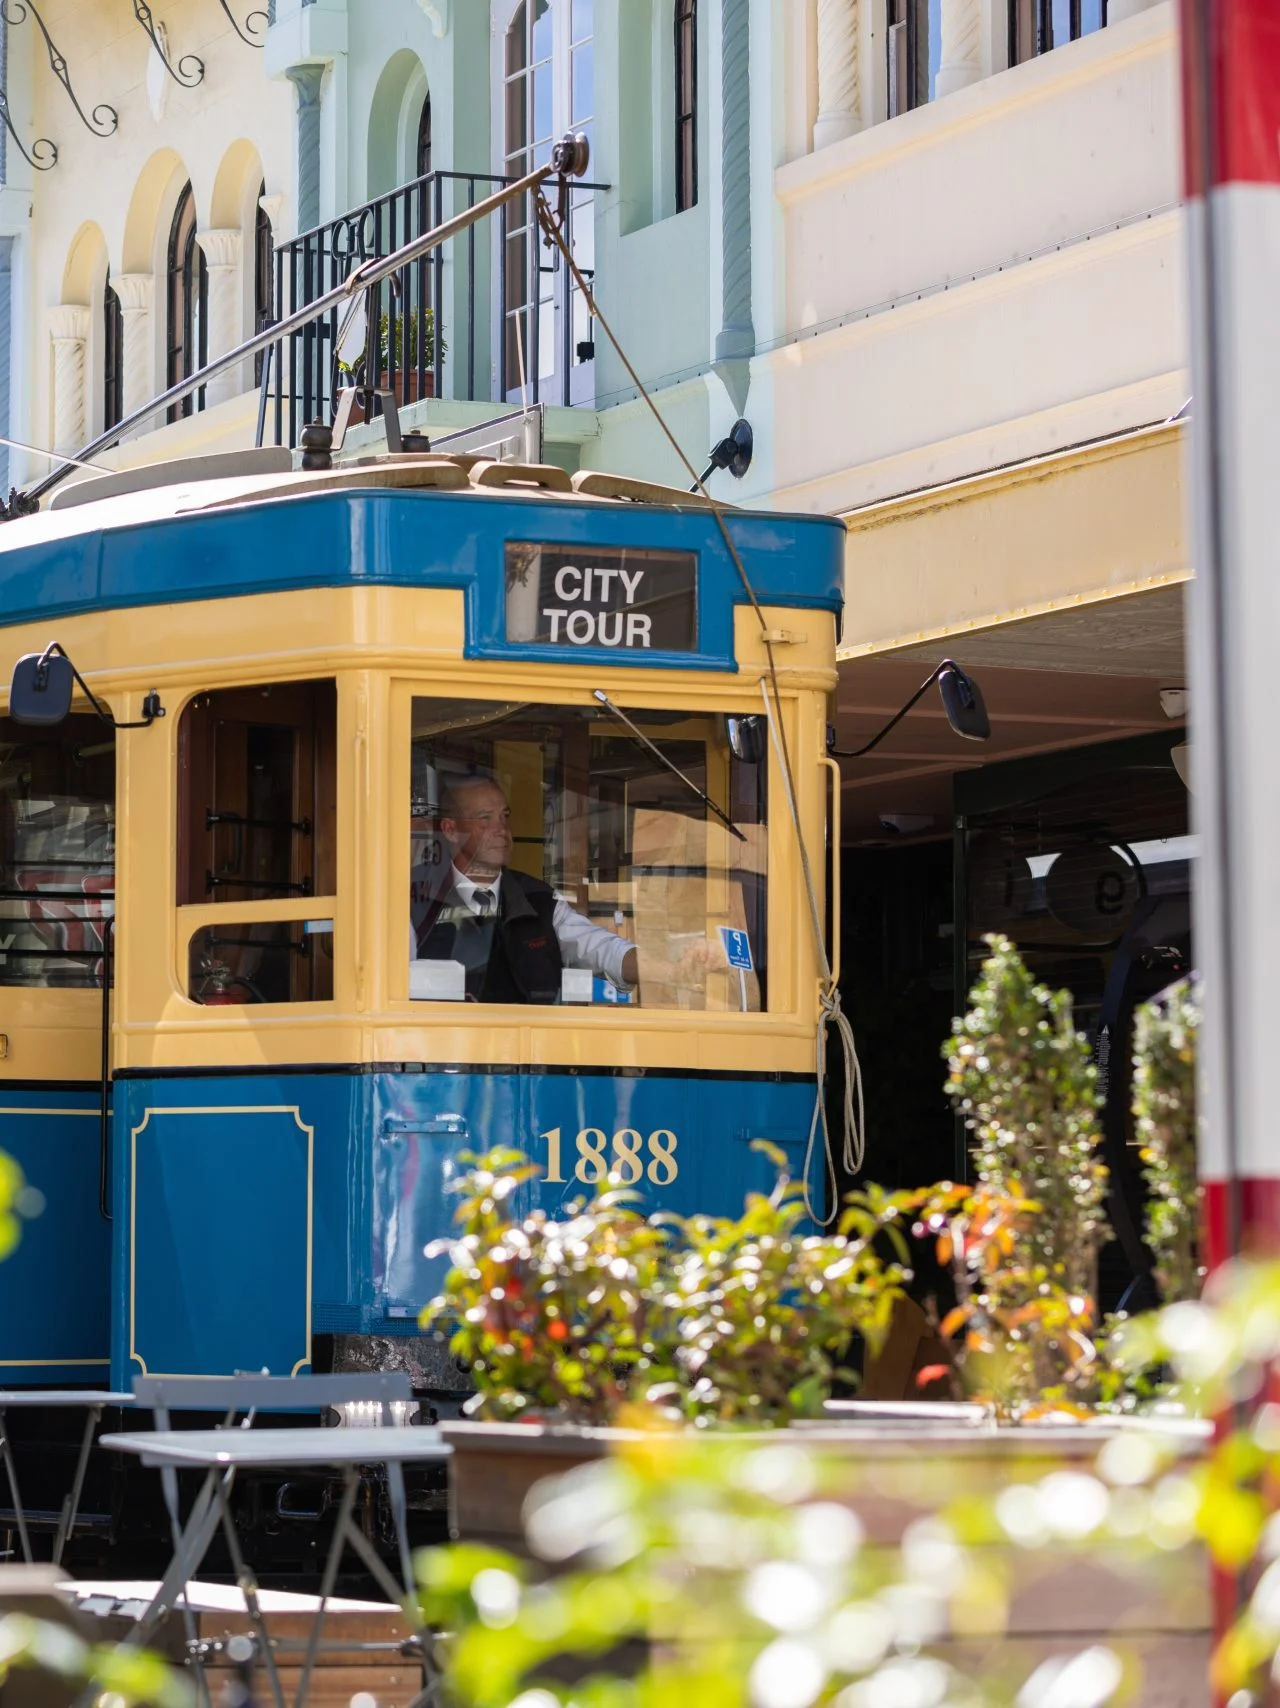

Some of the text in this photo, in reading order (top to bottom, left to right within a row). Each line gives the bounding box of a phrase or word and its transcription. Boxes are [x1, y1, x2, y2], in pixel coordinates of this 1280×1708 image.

[554, 565, 645, 604] CITY
[542, 608, 652, 648] TOUR
[539, 1127, 678, 1186] 1888
